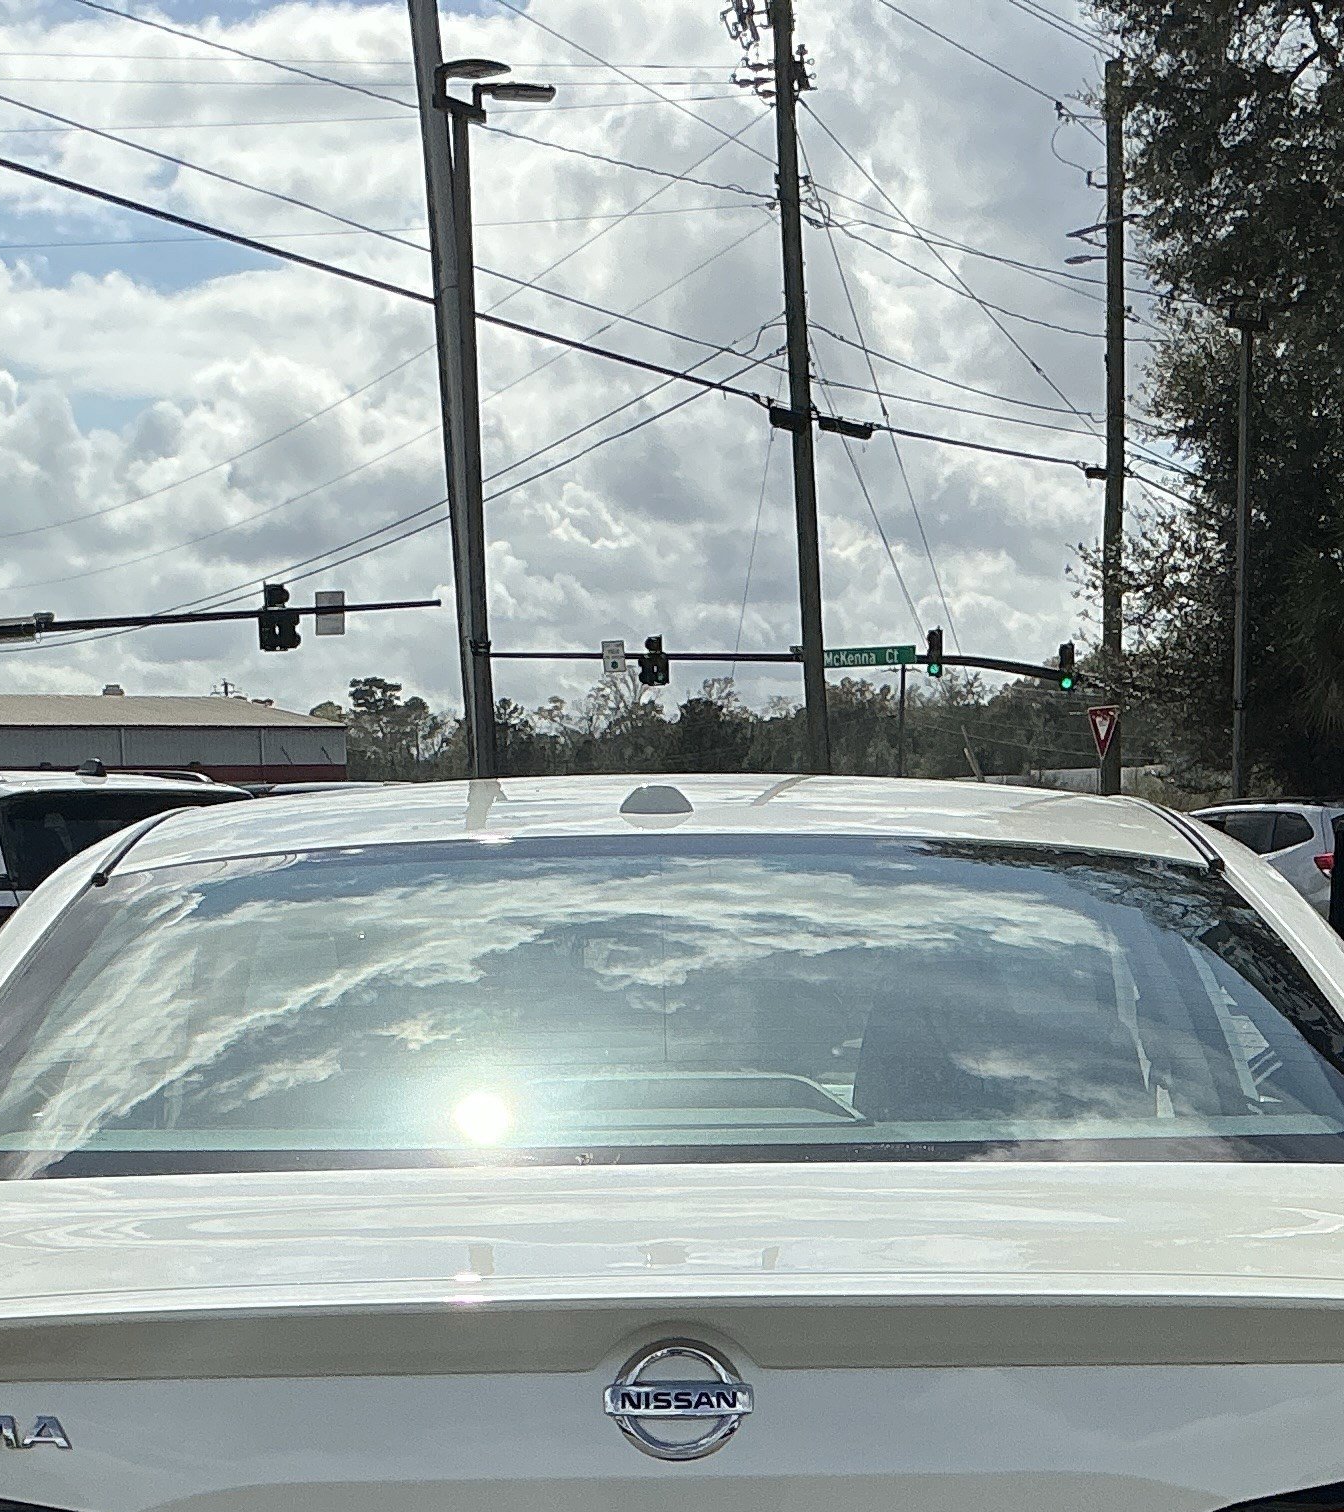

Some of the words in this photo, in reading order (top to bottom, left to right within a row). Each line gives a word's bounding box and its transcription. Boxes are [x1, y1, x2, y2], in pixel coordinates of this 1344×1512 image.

[823, 650, 876, 666] McKenna
[885, 648, 899, 664] Ct
[620, 1391, 738, 1410] NISSAN
